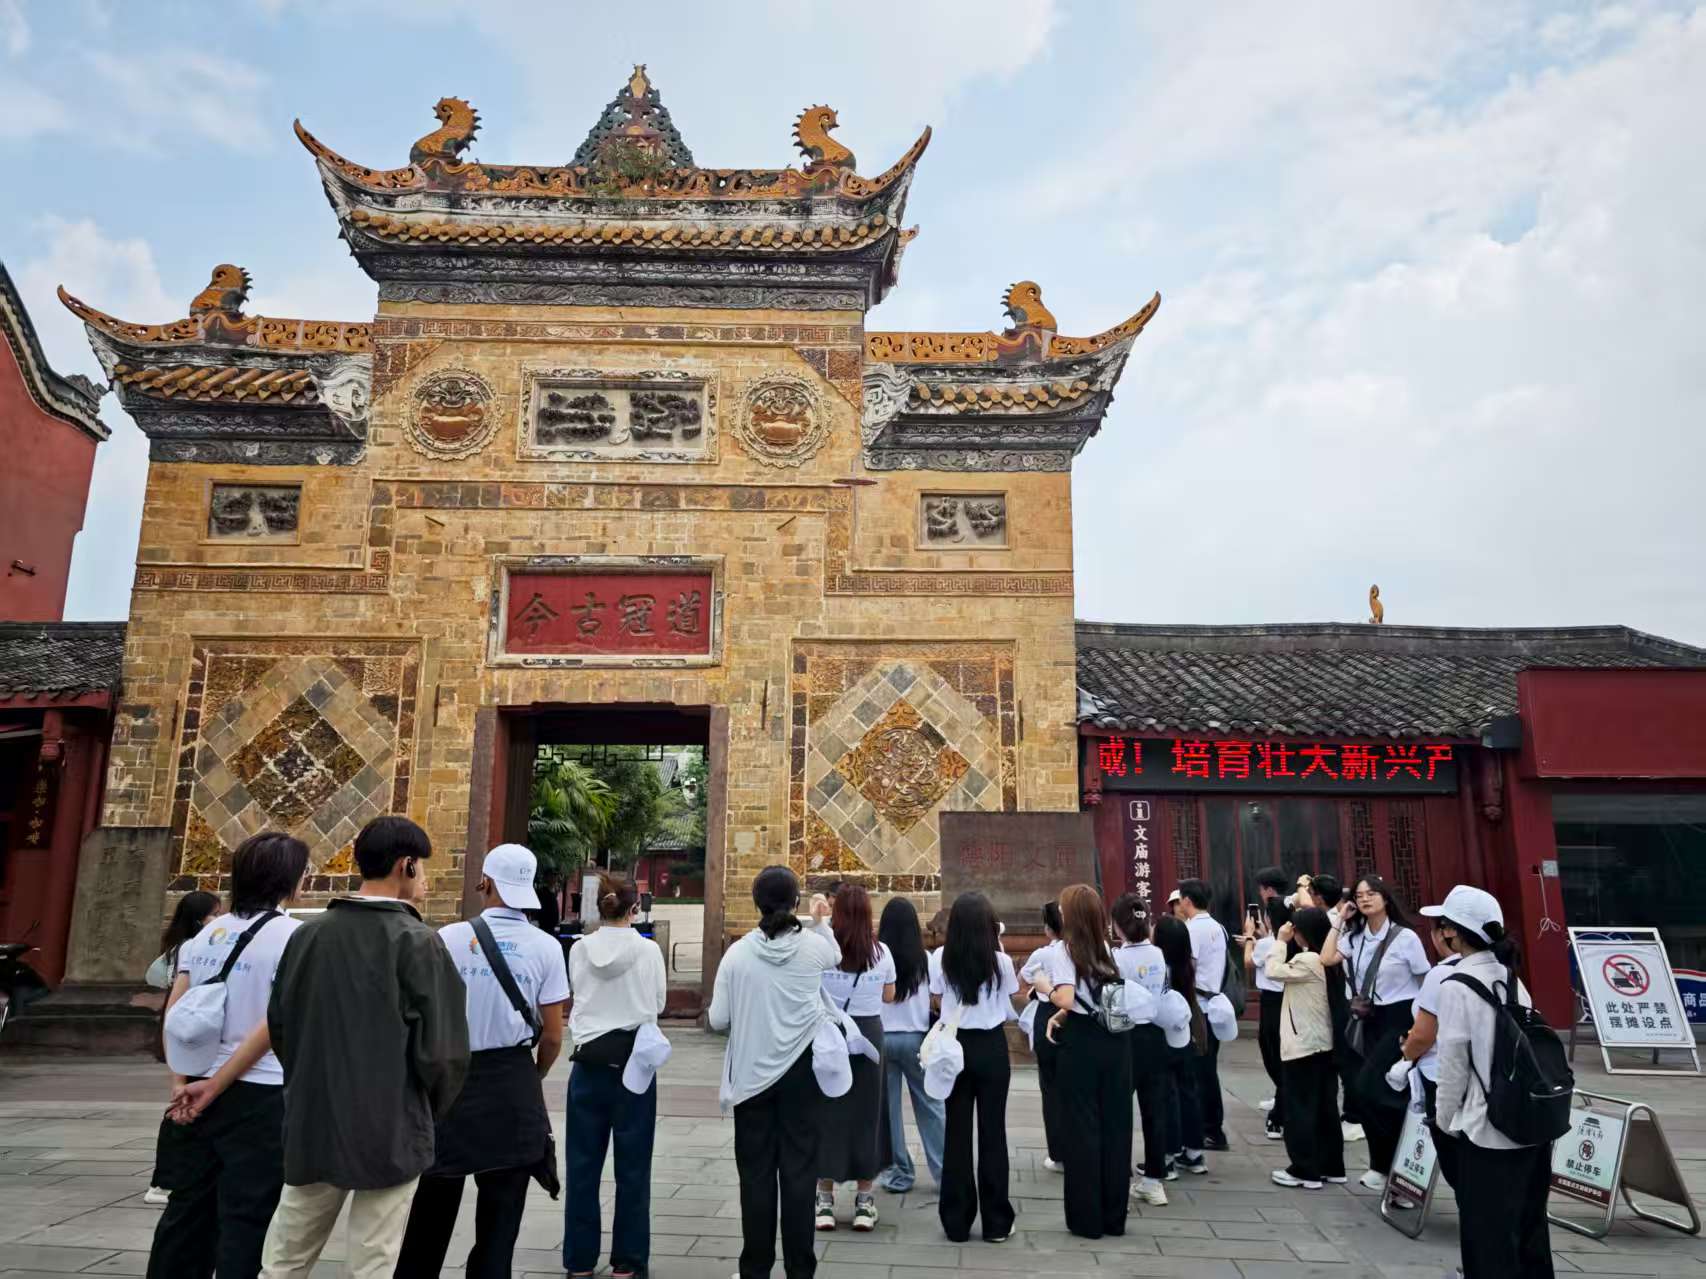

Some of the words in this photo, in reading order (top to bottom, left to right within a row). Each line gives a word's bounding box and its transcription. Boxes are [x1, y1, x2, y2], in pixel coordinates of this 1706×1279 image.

[1134, 825, 1152, 903] 文庙游客
[1605, 1001, 1669, 1014] 此处严禁
[1608, 1016, 1673, 1029] 摆摊设点
[1566, 1158, 1602, 1177] 禁止停车
